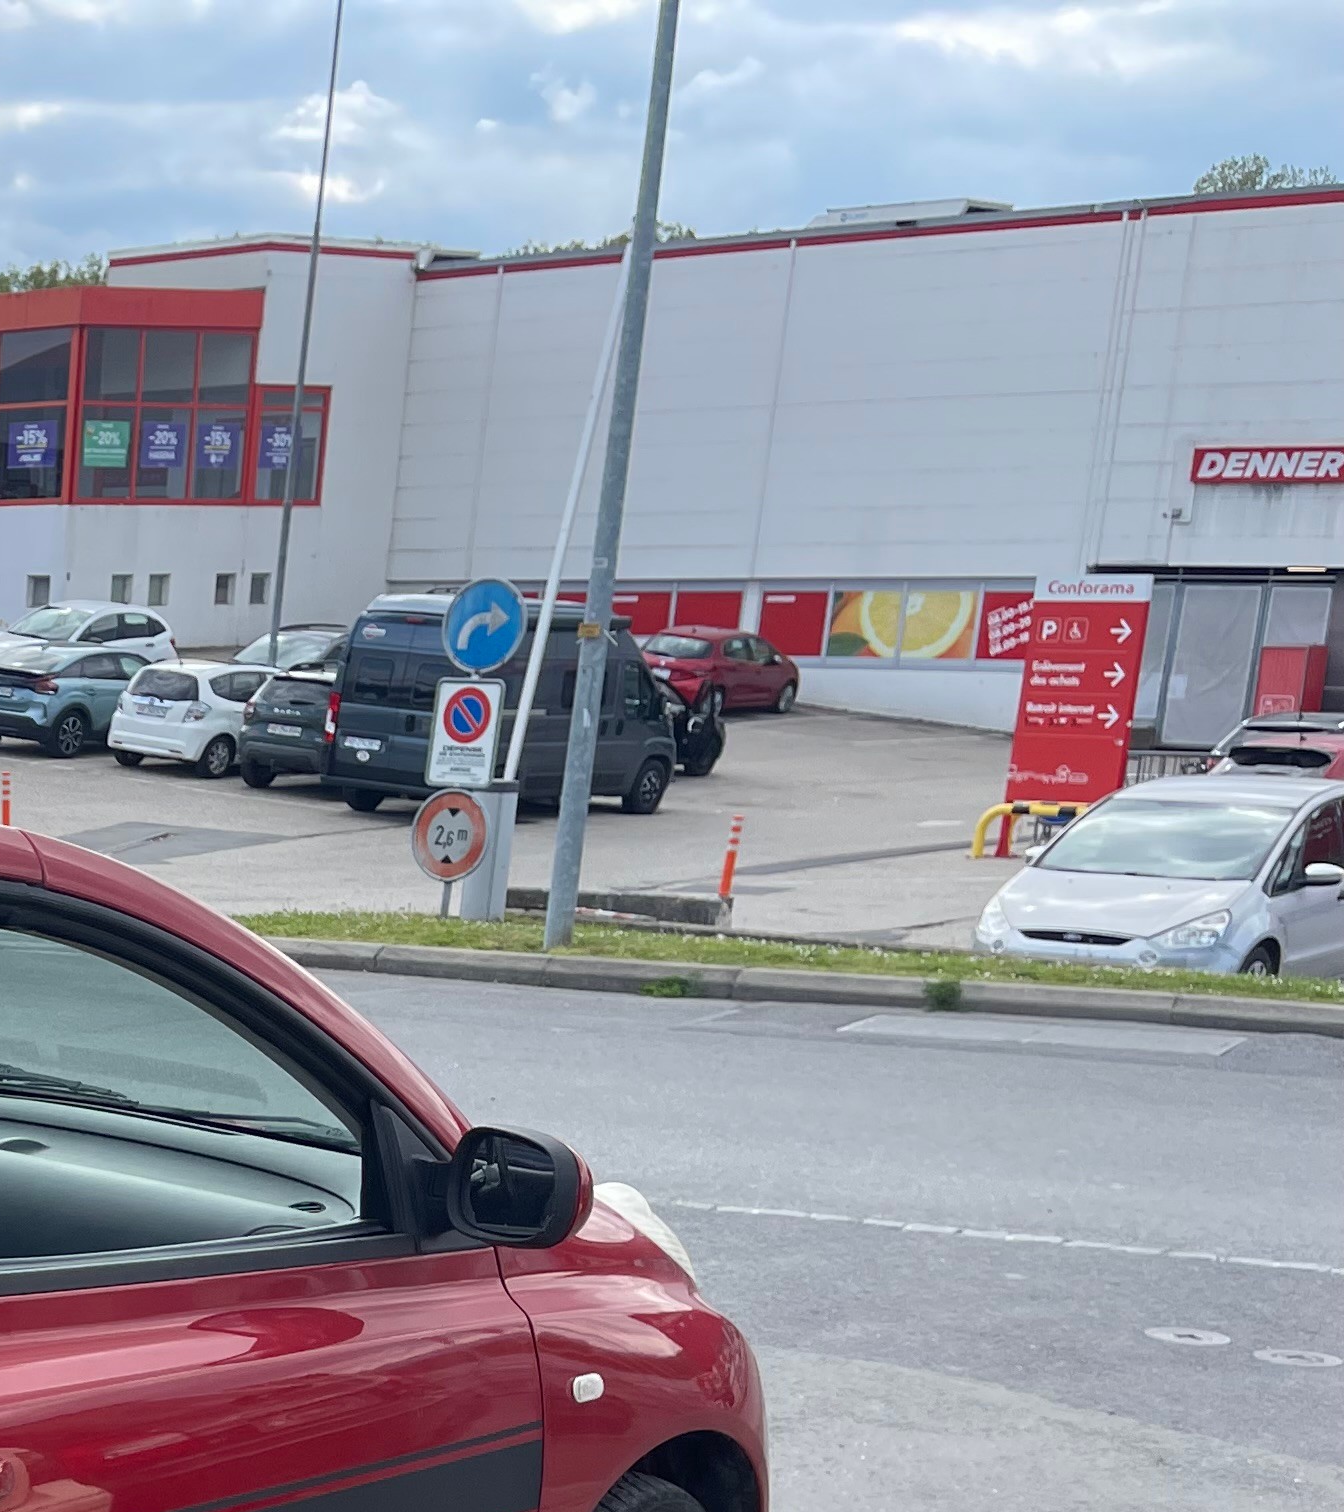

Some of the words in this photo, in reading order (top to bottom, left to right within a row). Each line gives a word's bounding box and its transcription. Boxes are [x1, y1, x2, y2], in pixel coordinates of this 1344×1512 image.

[1196, 451, 1344, 479] DENNER
[1048, 580, 1134, 597] Conforama
[1042, 620, 1057, 640] P
[434, 825, 455, 849] 2,6
[457, 829, 468, 841] m
